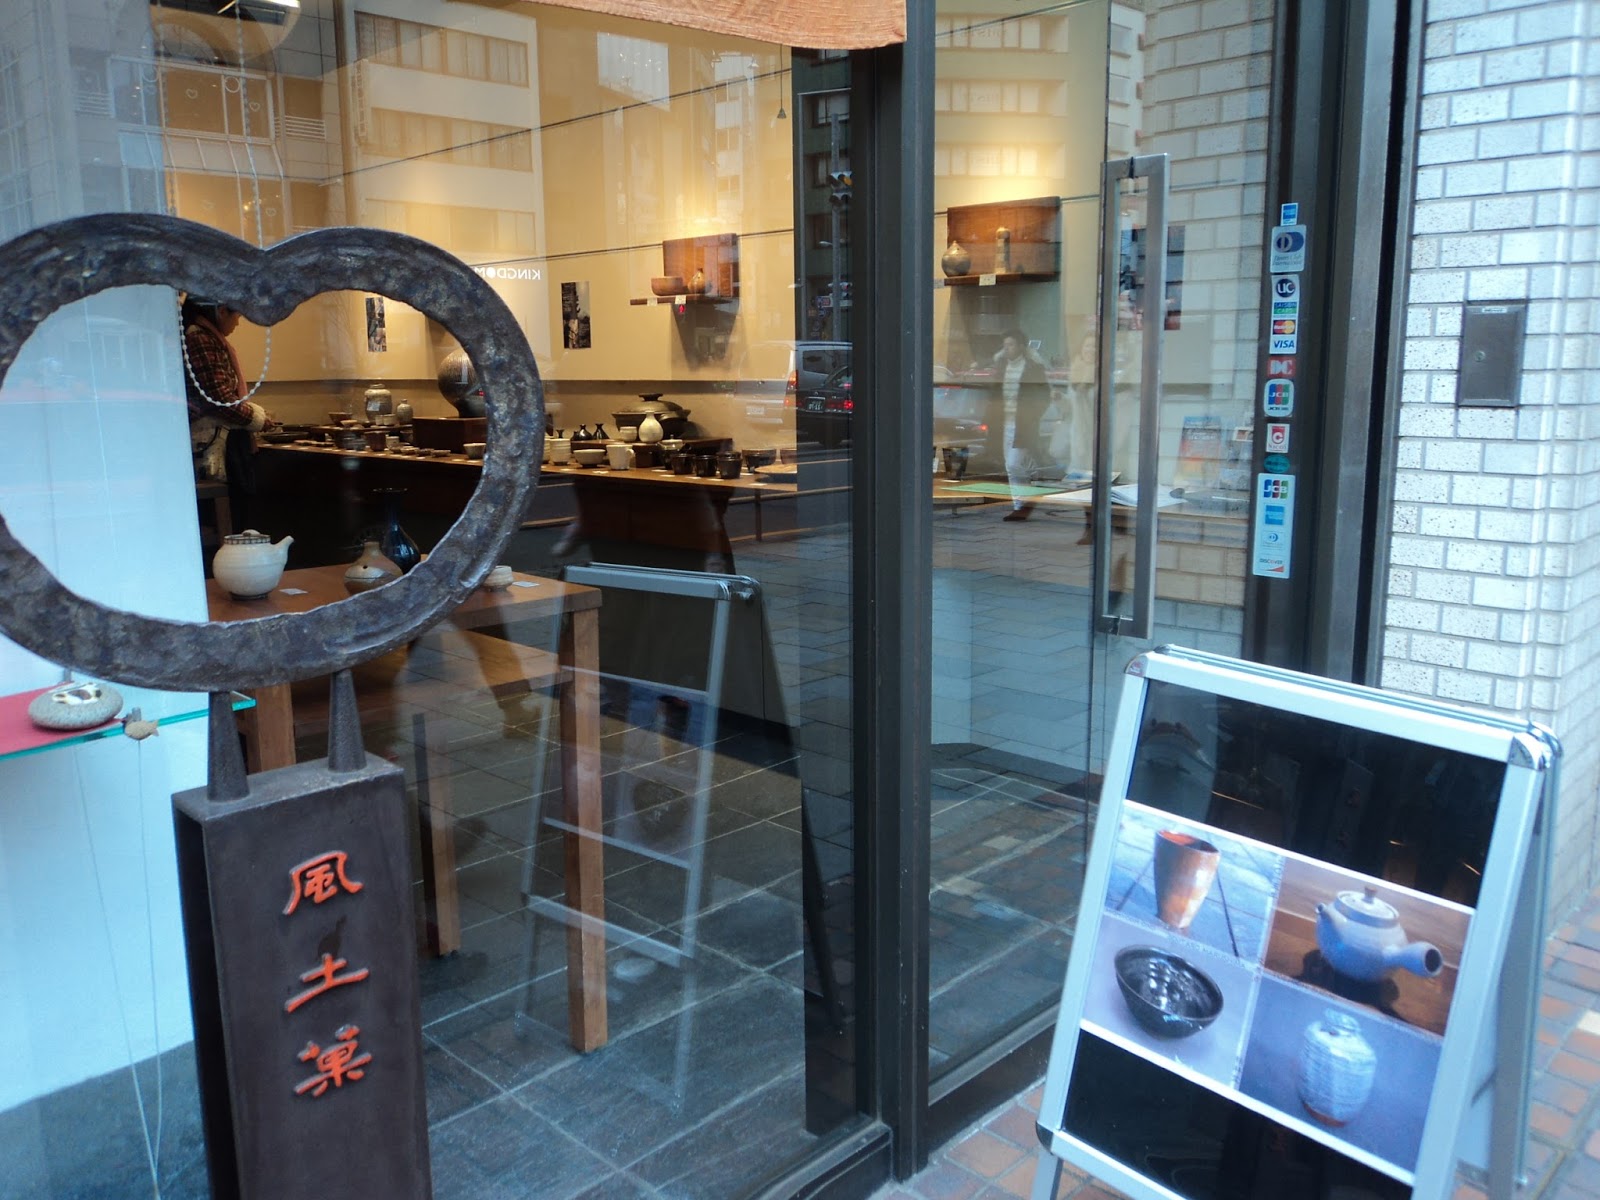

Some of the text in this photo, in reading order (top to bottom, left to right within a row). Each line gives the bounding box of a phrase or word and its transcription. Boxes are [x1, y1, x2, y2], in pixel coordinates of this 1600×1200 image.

[1277, 282, 1295, 293] UC
[1273, 340, 1295, 349] VISA
[1270, 360, 1293, 375] DC
